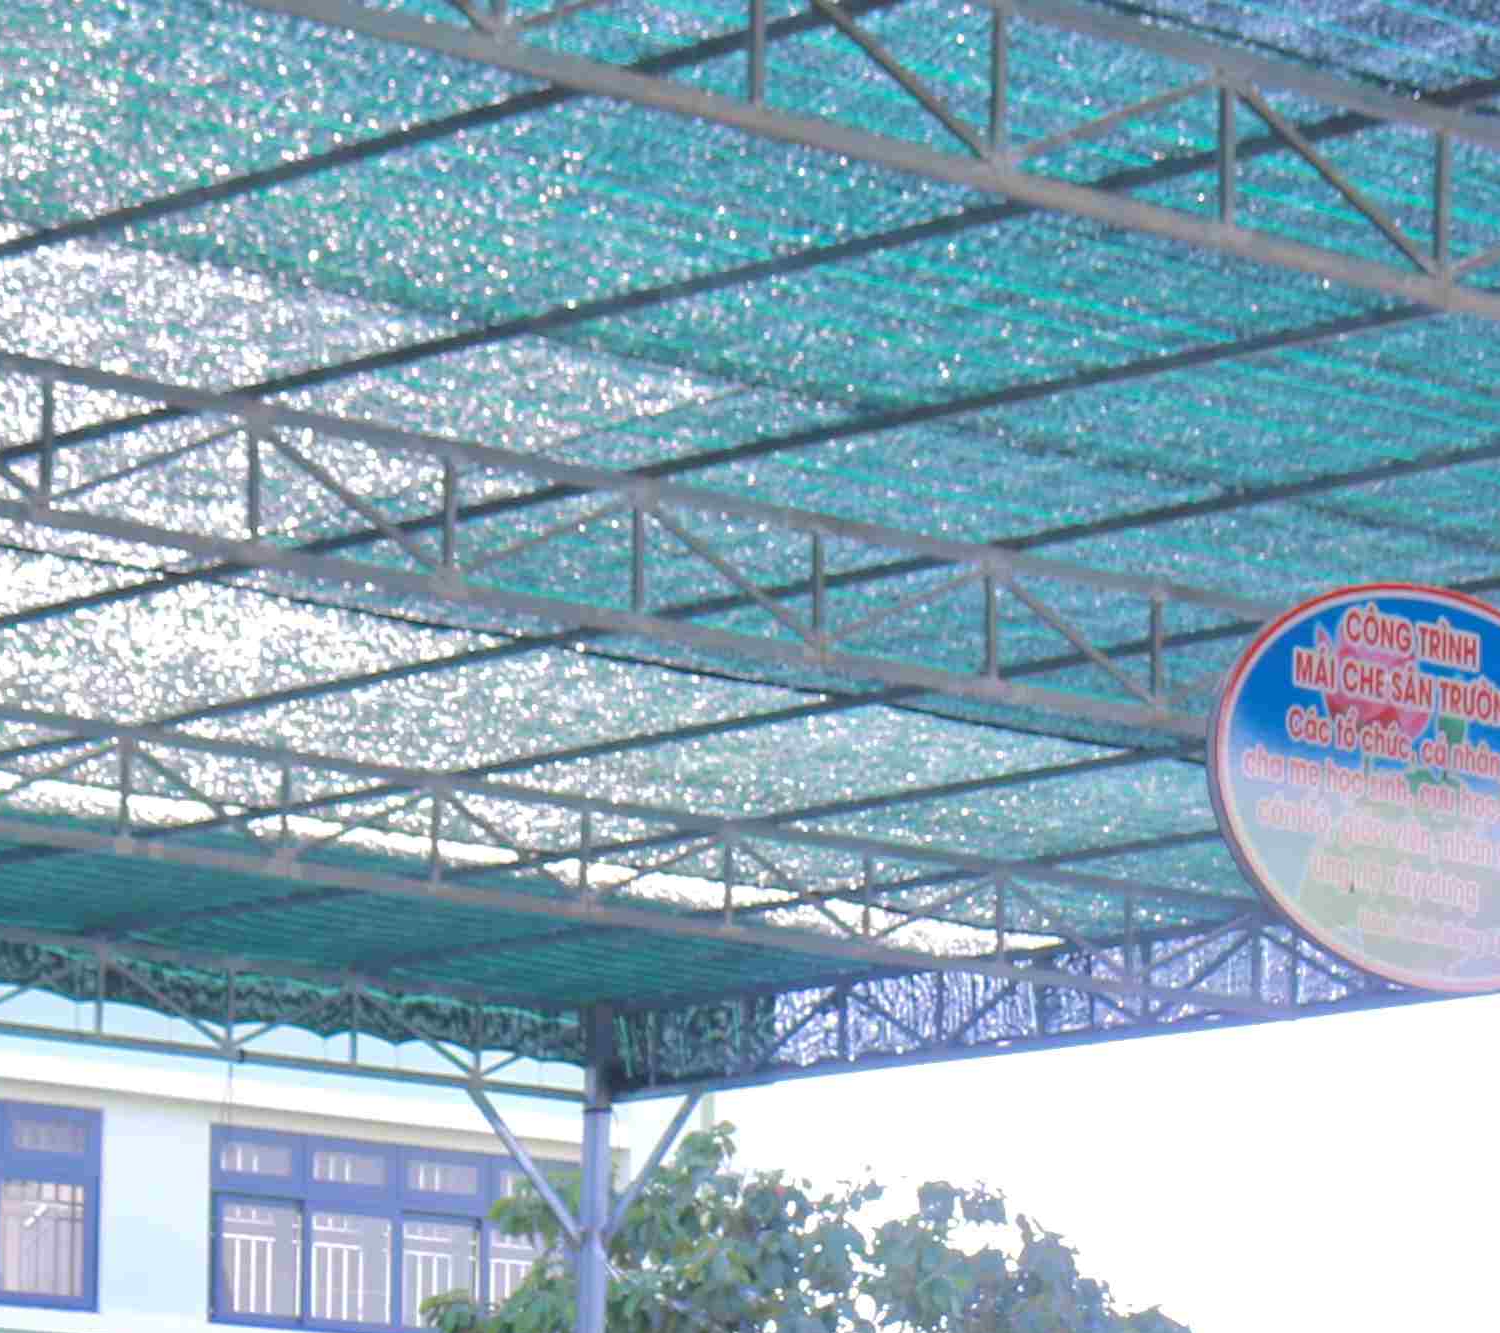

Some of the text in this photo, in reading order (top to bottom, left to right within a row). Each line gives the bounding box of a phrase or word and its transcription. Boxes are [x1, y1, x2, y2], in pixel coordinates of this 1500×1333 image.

[1346, 604, 1478, 668] CÔNG TRÌNH
[1343, 660, 1385, 698] CHE
[1288, 706, 1331, 745] Các
